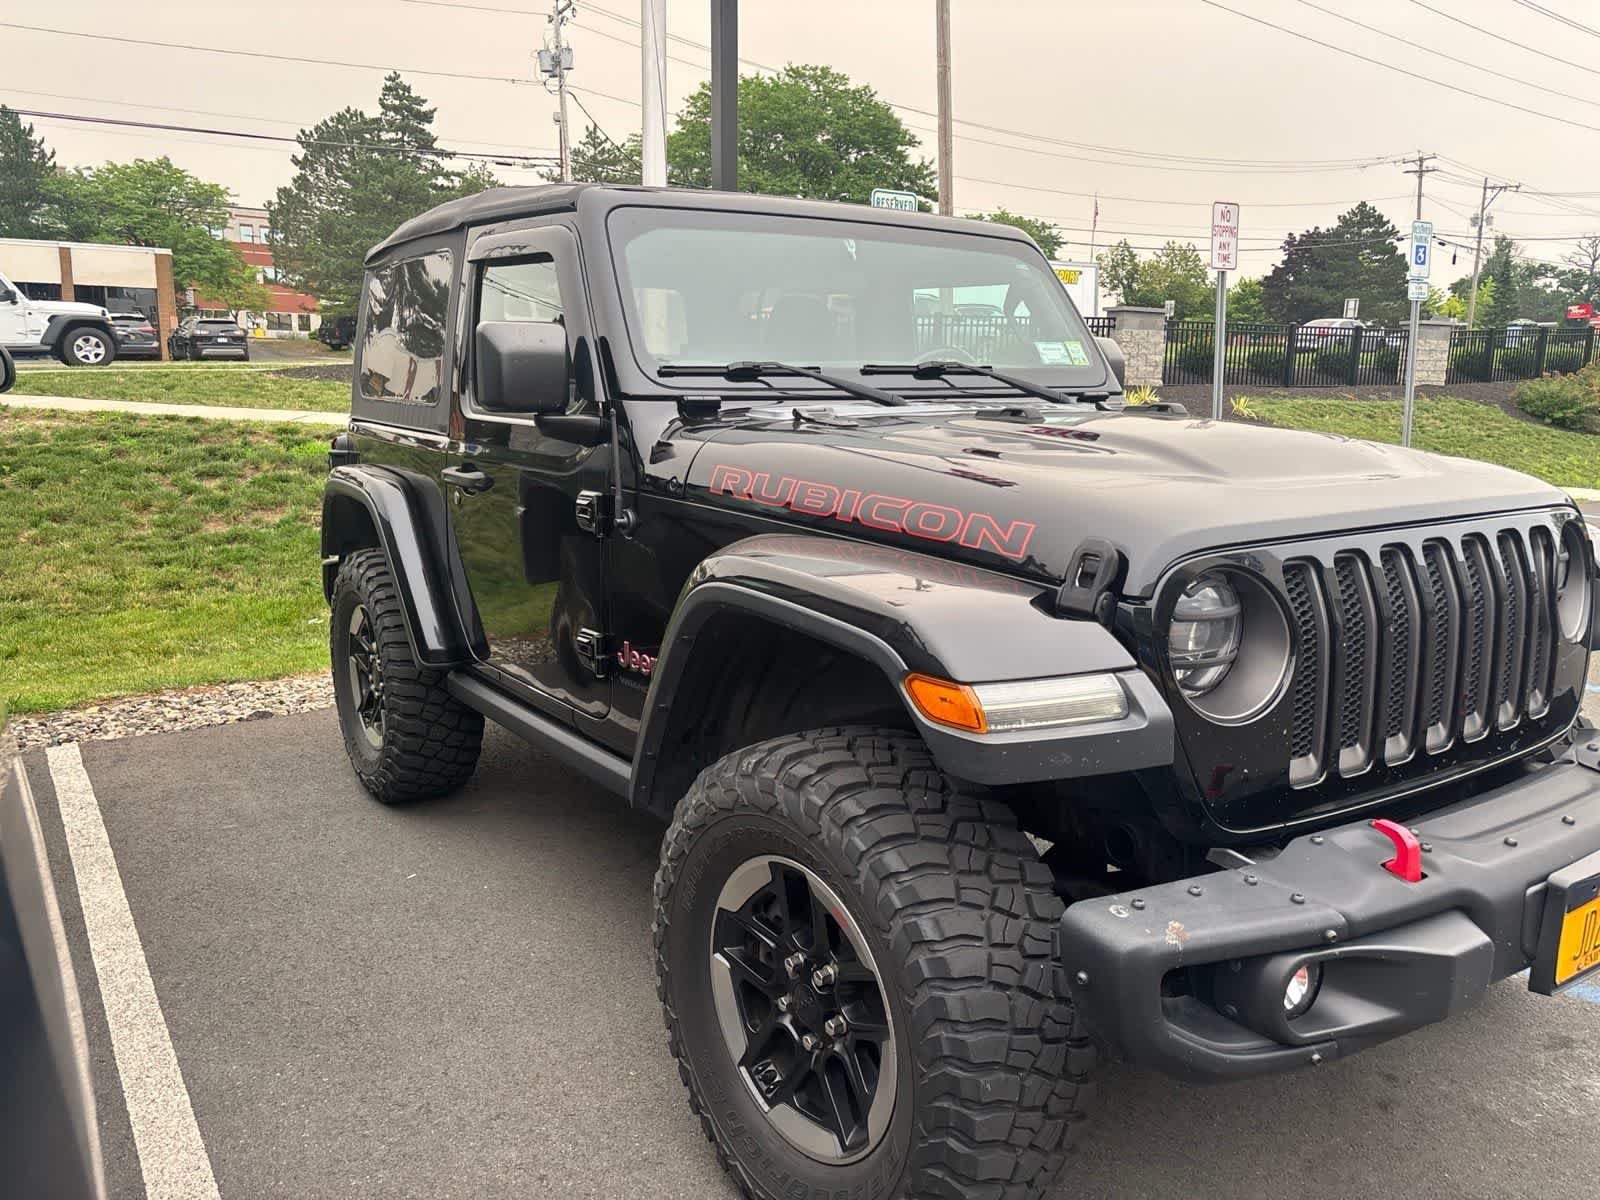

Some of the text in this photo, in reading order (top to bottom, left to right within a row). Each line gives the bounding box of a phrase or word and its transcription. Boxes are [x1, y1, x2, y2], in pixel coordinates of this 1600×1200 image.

[876, 197, 913, 211] RESERVED
[1220, 209, 1231, 222] NO
[1213, 225, 1236, 238] STOPPING
[1218, 241, 1230, 251] ANY
[1217, 253, 1231, 264] TIME
[709, 464, 1036, 558] RUBICON
